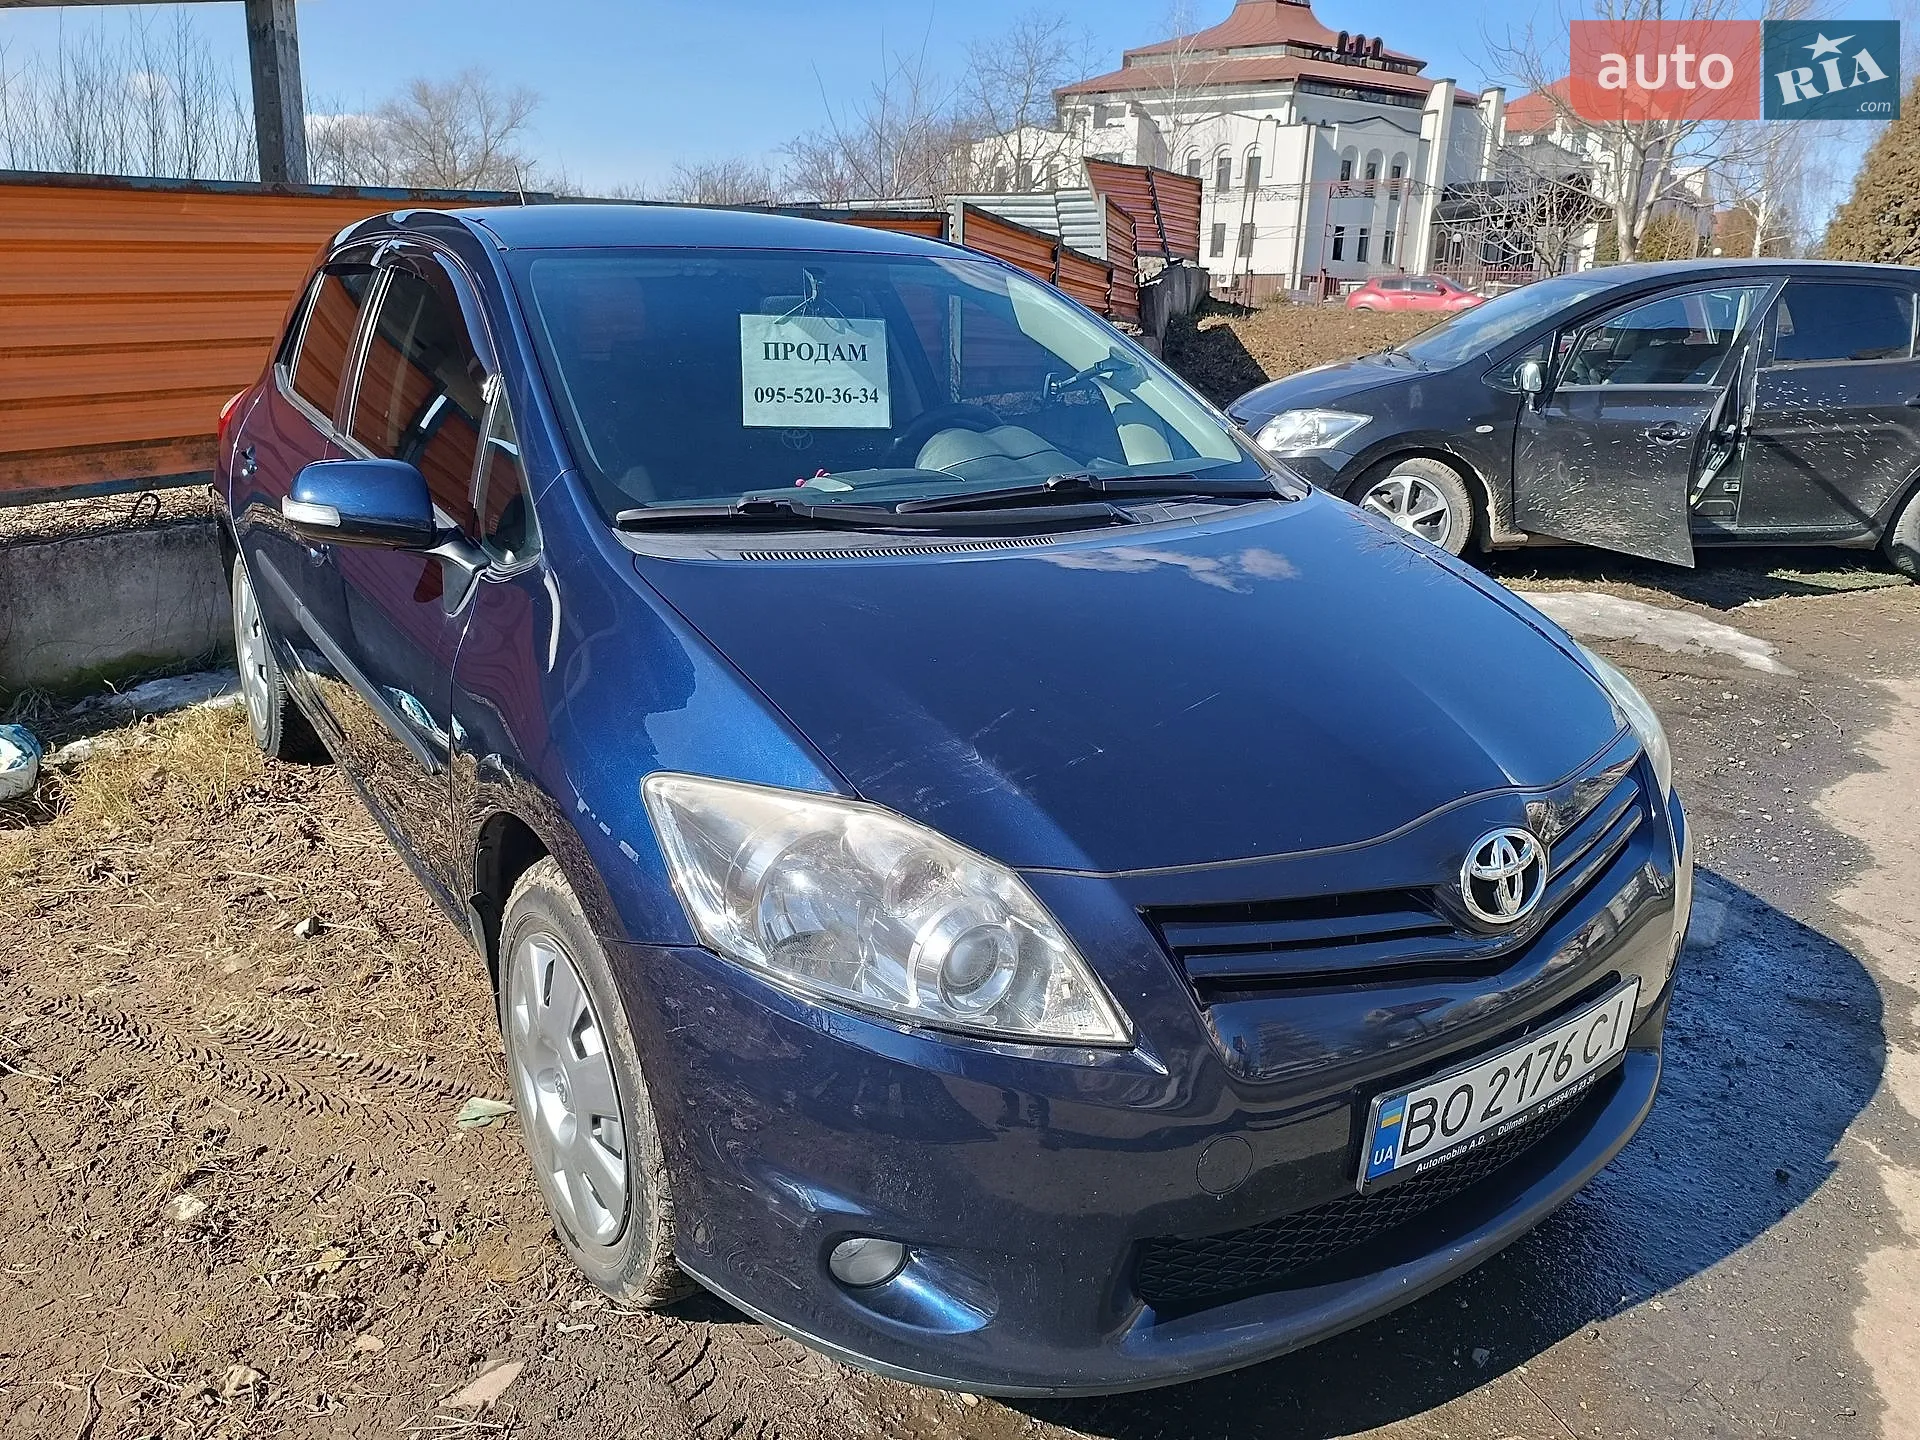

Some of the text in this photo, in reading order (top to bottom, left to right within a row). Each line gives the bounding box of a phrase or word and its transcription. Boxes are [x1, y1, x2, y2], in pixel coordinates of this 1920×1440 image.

[763, 342, 868, 365] ПРОДАМ
[754, 387, 879, 403] 095-520-36-34
[1373, 1145, 1393, 1166] UA
[1415, 1145, 1468, 1174] Automobile
